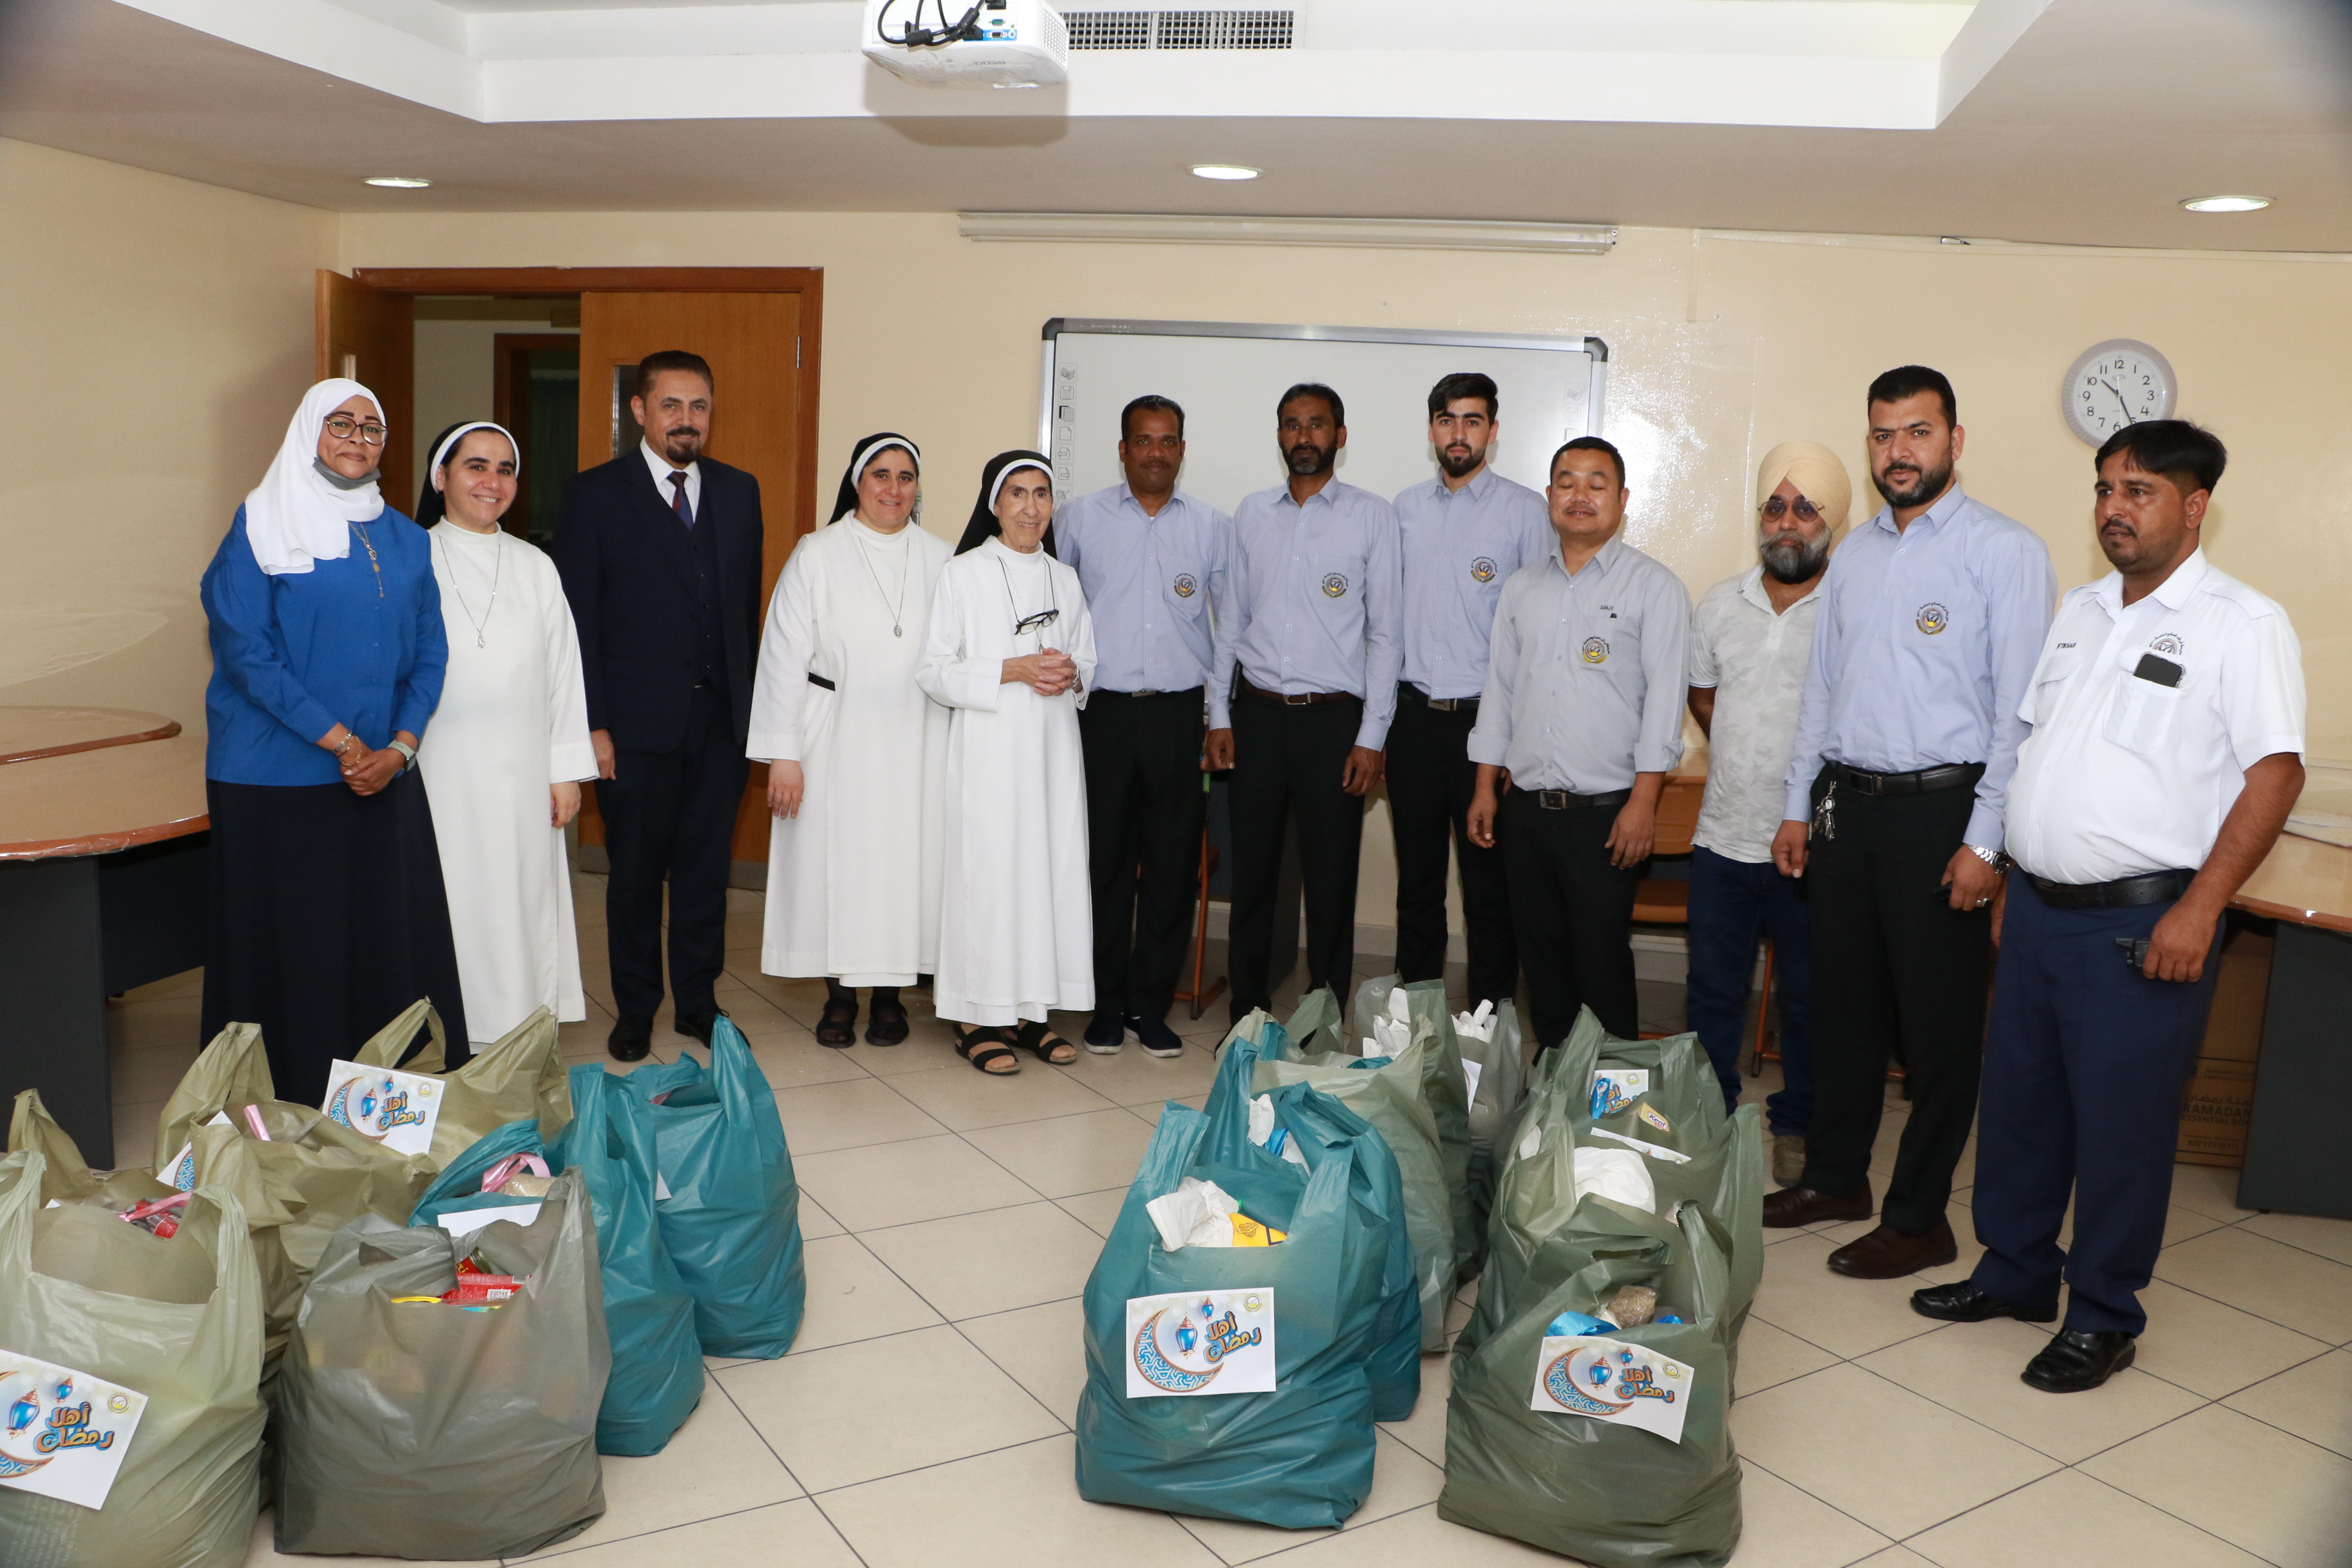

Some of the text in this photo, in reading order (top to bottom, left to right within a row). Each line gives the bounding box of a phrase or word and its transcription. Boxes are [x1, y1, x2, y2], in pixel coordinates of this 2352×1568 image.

[2100, 365, 2107, 374] 11
[2114, 360, 2124, 369] 12
[2134, 364, 2136, 374] 1
[2087, 377, 2097, 385] 10
[2142, 375, 2150, 385] 2
[2083, 391, 2090, 401] 9
[2147, 390, 2154, 401] 3
[2087, 406, 2094, 416] 8
[2140, 406, 2149, 416] 4
[2098, 417, 2105, 427] 7
[2183, 1103, 2251, 1118] RAMADAN
[377, 1111, 425, 1131] رمضان
[1649, 1114, 1666, 1127] Kent
[2182, 1114, 2229, 1124] ESSENTIAL
[1204, 1327, 1262, 1363] رمضان
[1615, 1382, 1675, 1402] رمضان
[34, 1427, 115, 1455] رمضان
